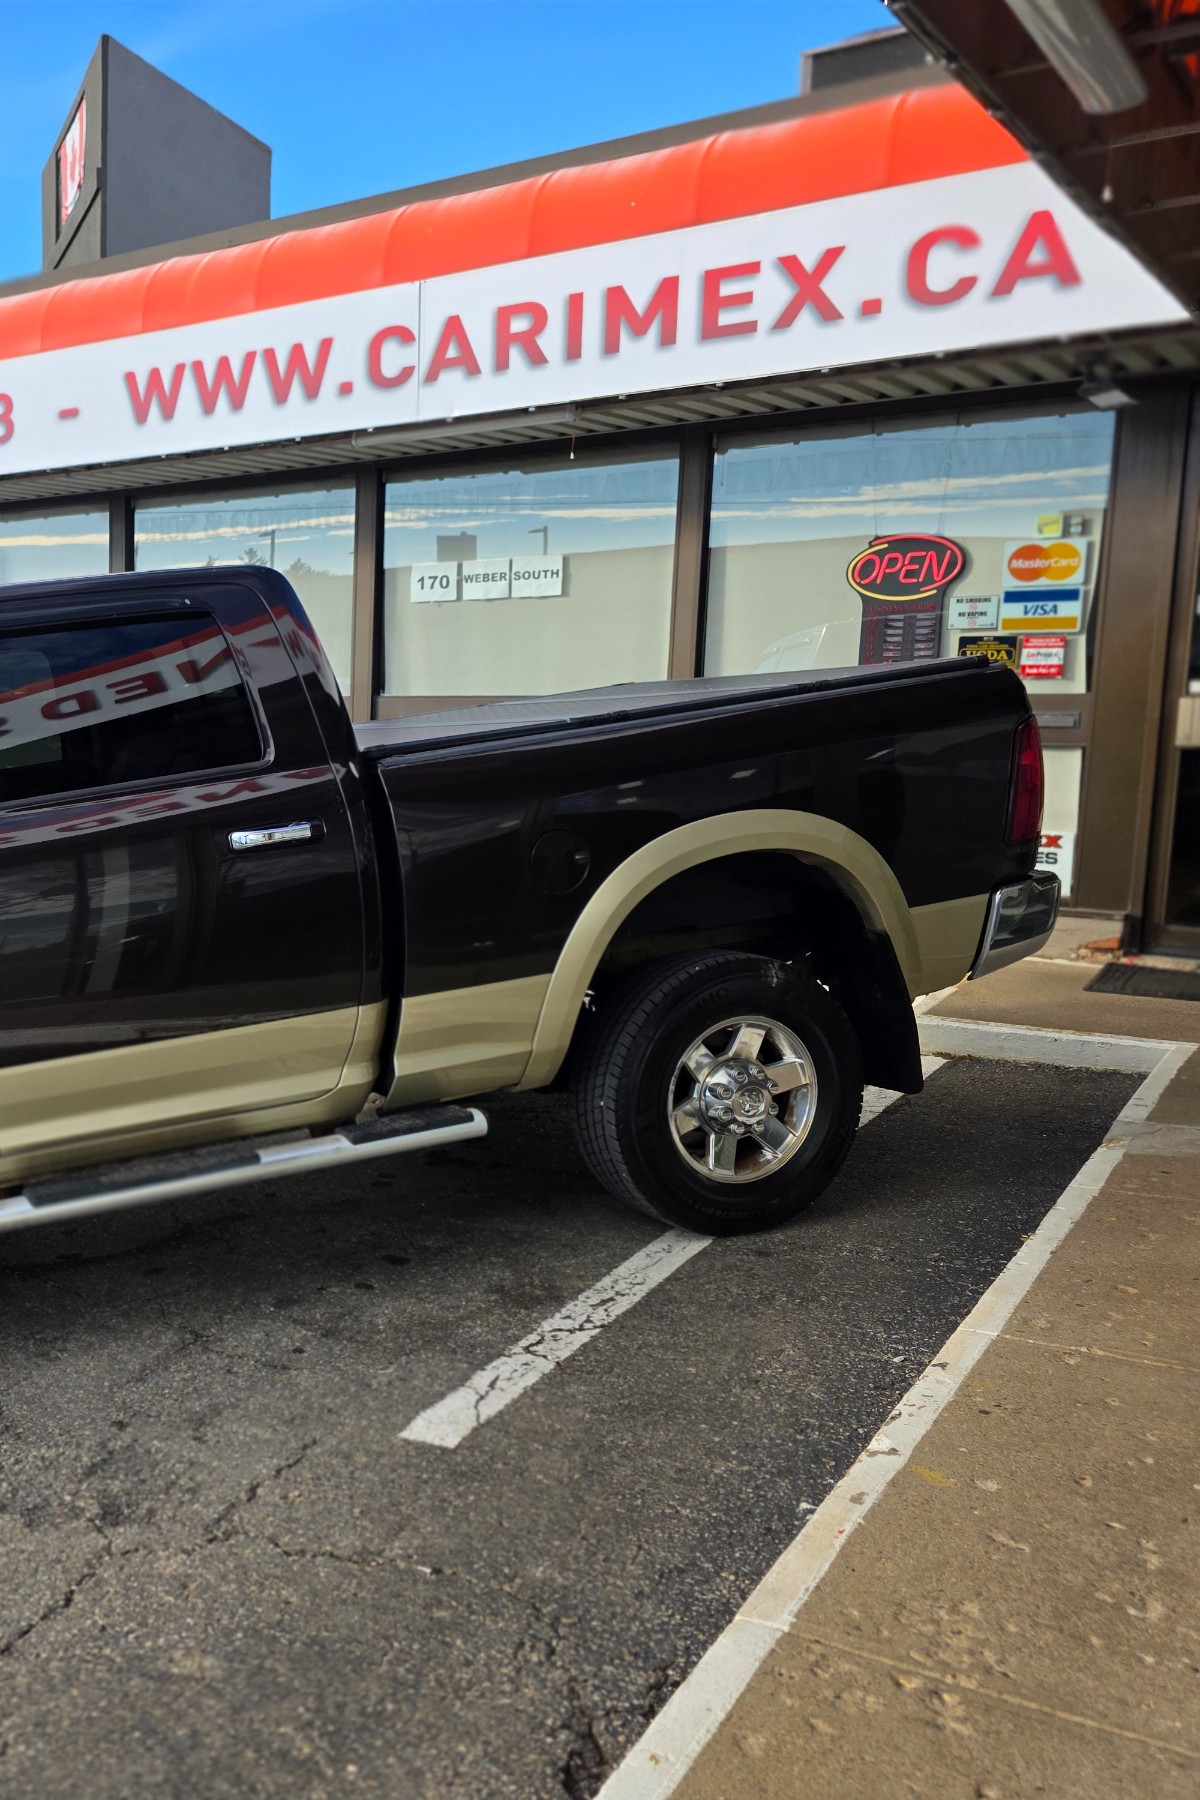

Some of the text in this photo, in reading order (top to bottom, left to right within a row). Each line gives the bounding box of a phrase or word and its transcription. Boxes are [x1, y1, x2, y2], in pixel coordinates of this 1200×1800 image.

[125, 209, 1082, 423] WWW.CARIMEX.CA
[854, 550, 951, 584] OPEN
[1010, 557, 1079, 569] MasterCard
[417, 569, 560, 591] 170 WEBER SOUTH
[1023, 604, 1058, 616] VISA
